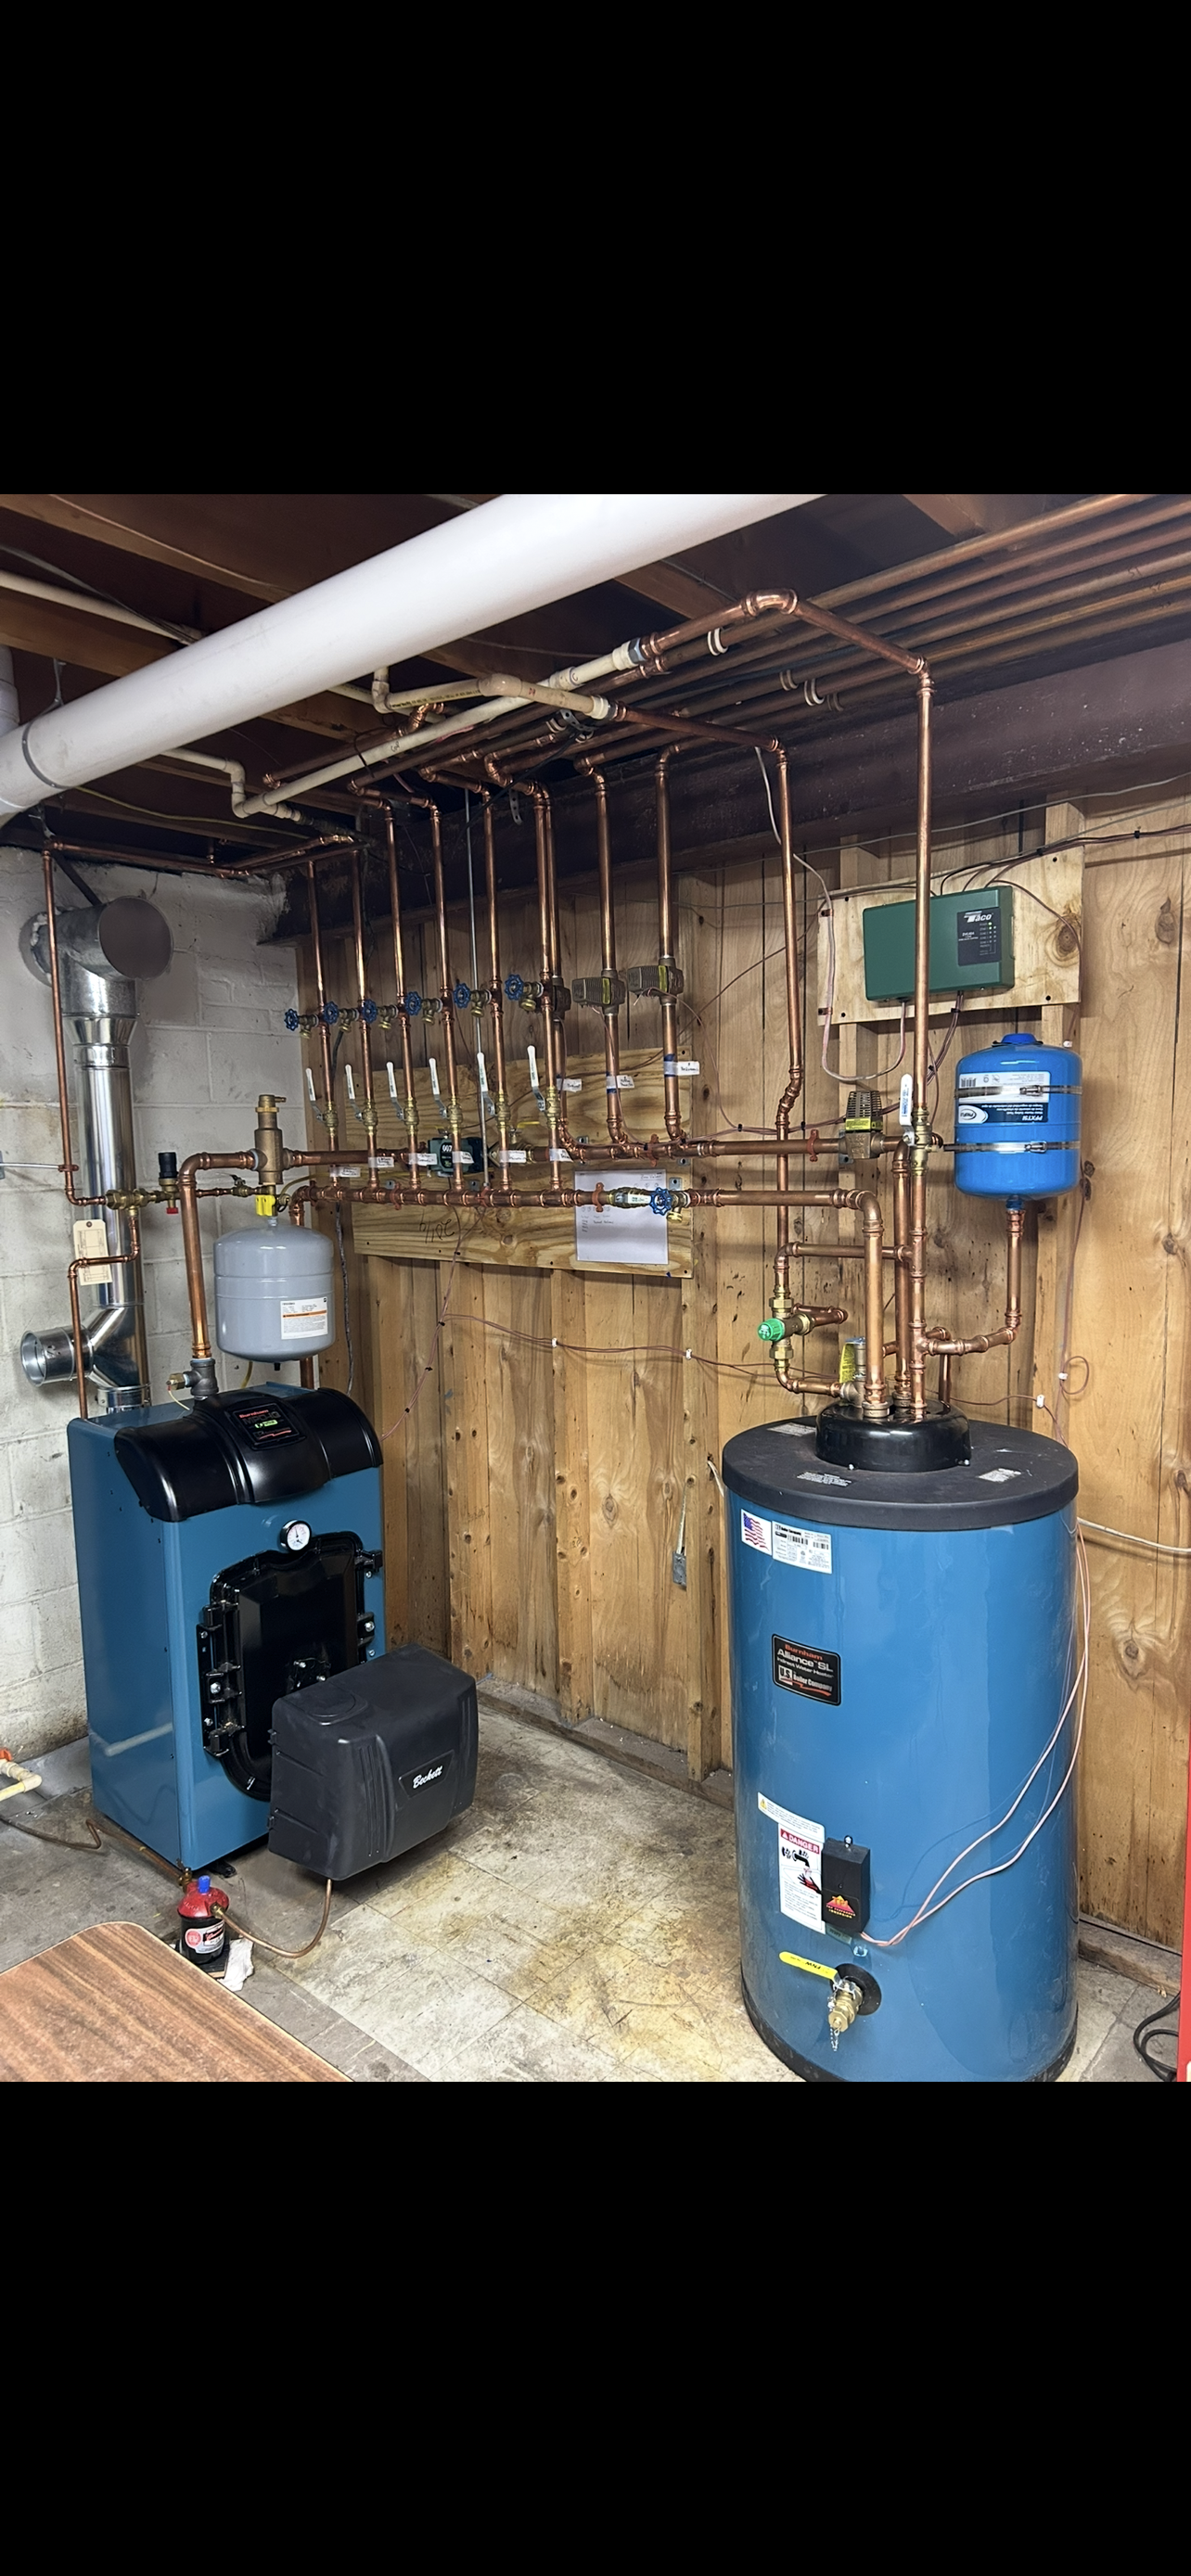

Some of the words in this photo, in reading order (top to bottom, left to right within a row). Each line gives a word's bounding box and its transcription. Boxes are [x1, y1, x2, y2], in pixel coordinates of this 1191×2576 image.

[784, 1644, 823, 1660] Burnham
[817, 1661, 834, 1673] SL
[412, 1766, 443, 1789] Beckett
[788, 1832, 819, 1854] DANGER
